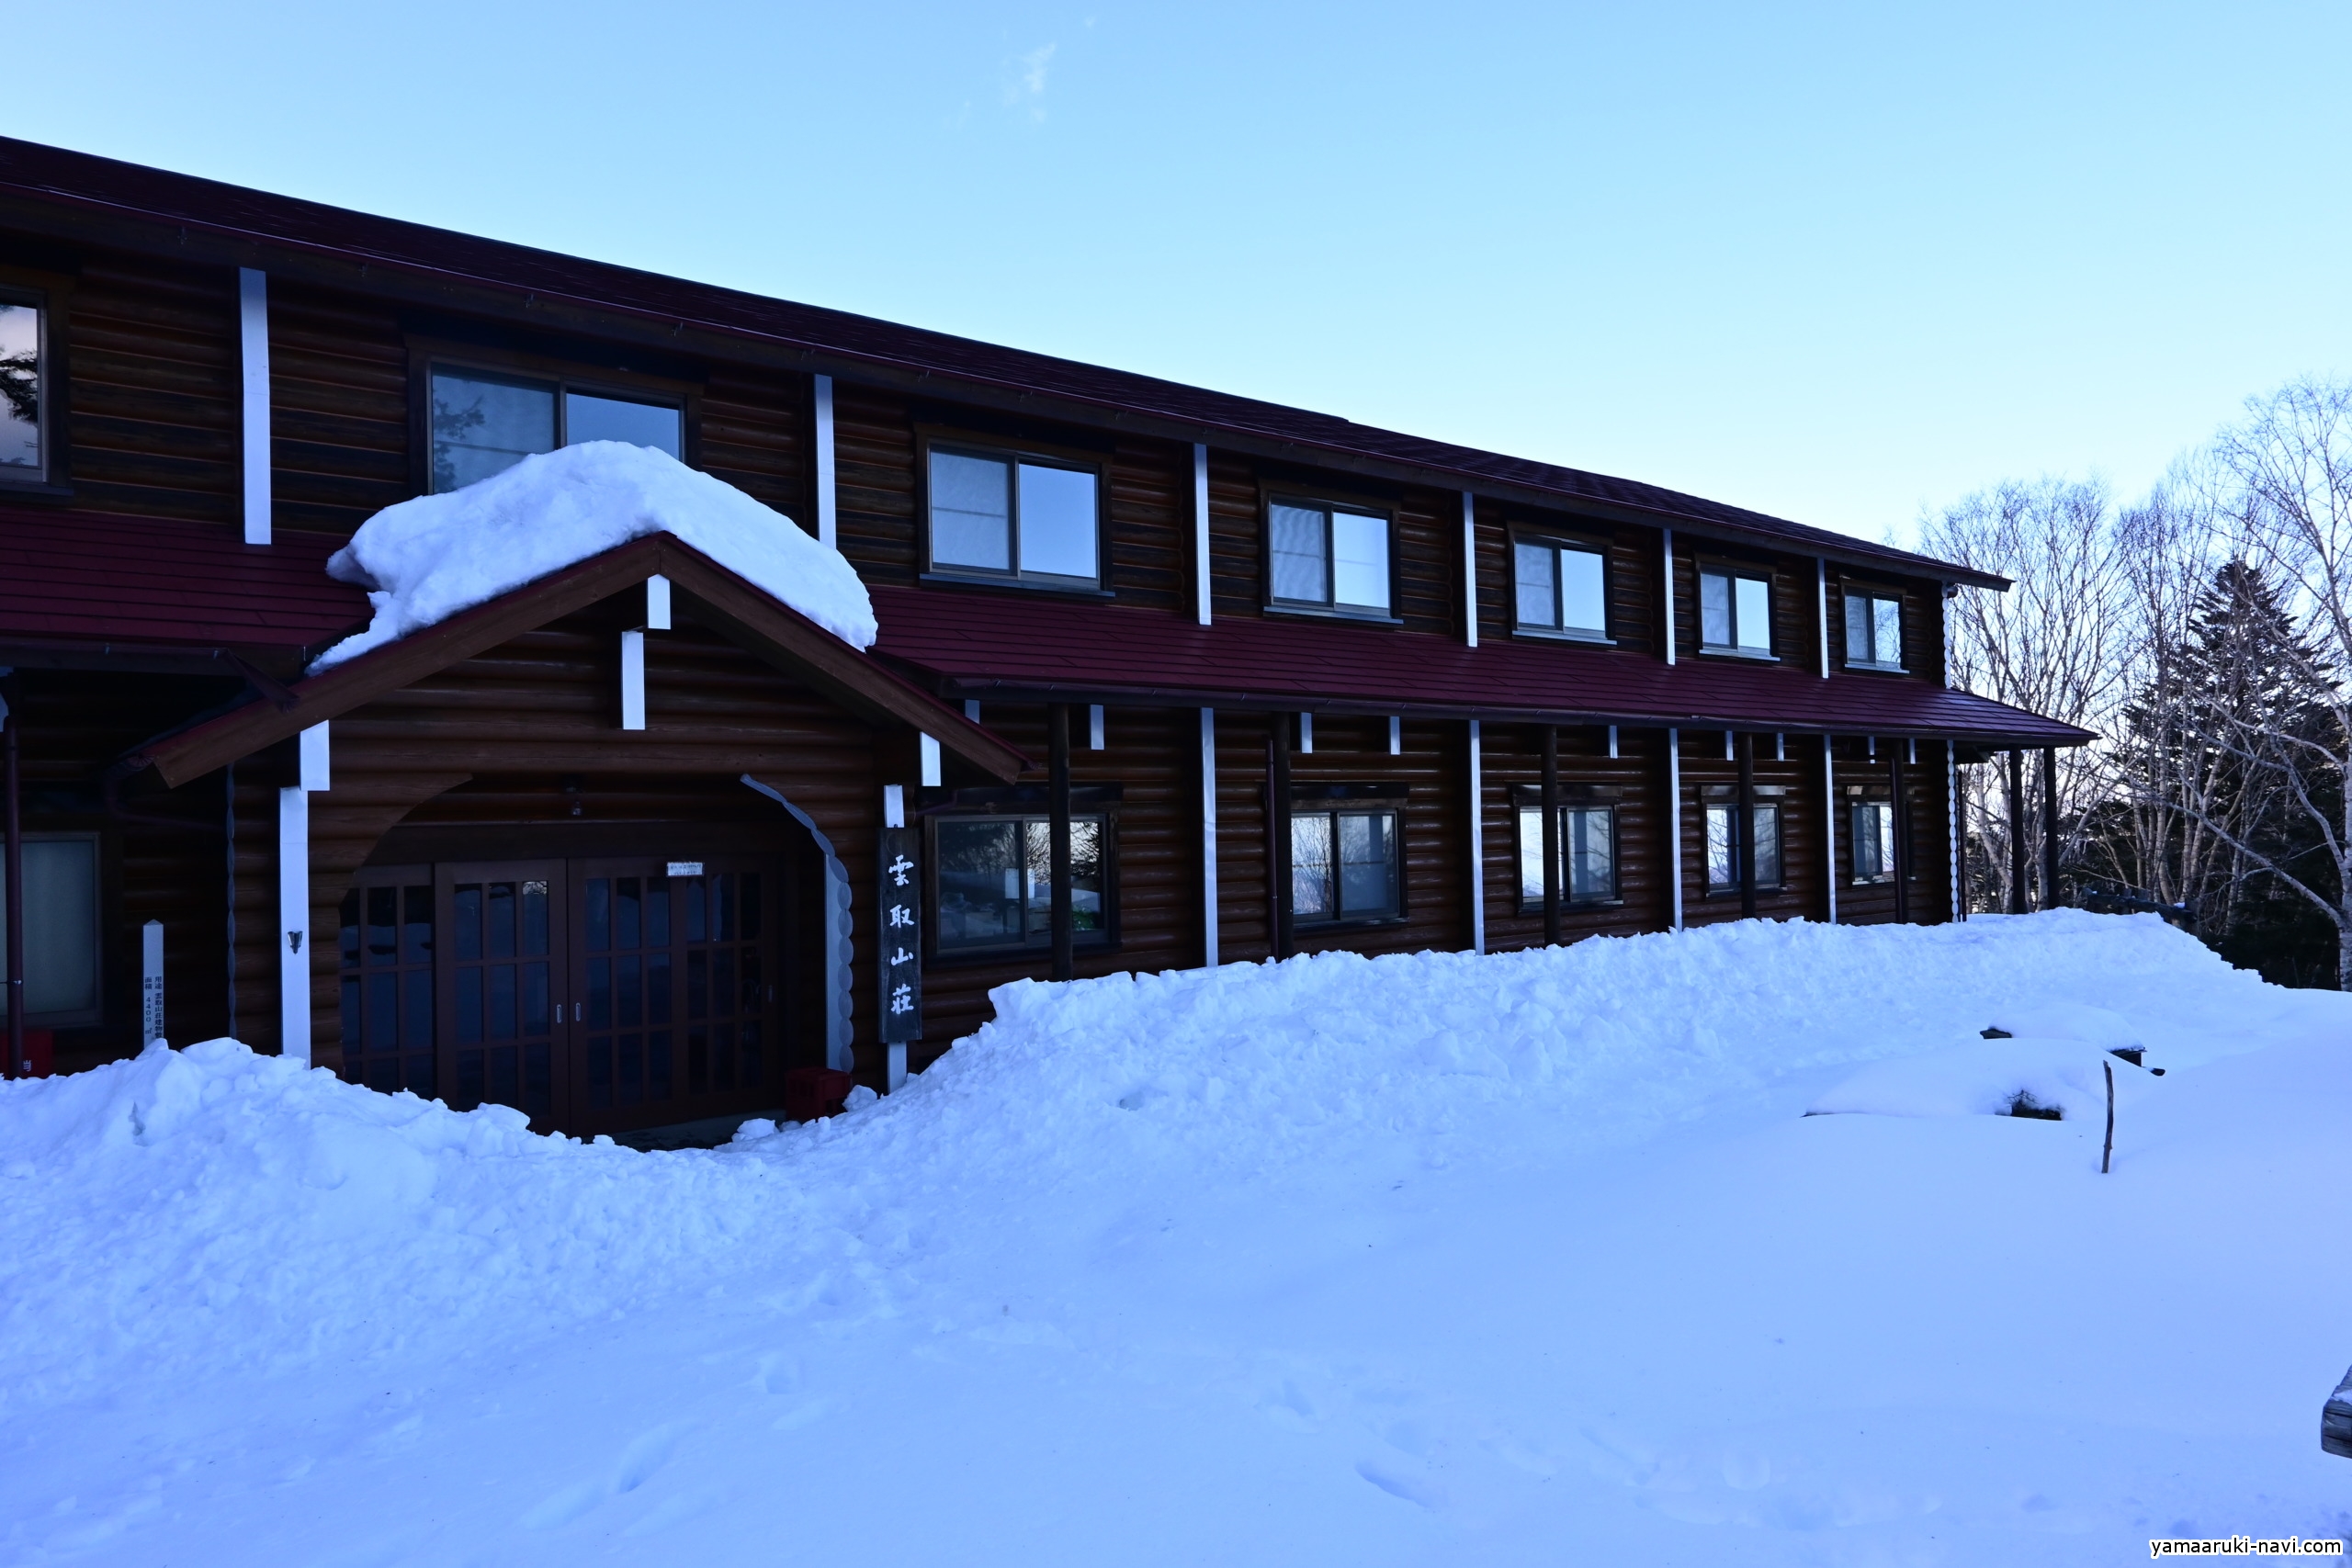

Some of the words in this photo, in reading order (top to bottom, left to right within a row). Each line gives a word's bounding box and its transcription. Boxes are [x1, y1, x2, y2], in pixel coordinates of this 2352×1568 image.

[888, 854, 915, 1015] 雲取山荘
[144, 976, 153, 990] 面積
[154, 976, 163, 990] 用途
